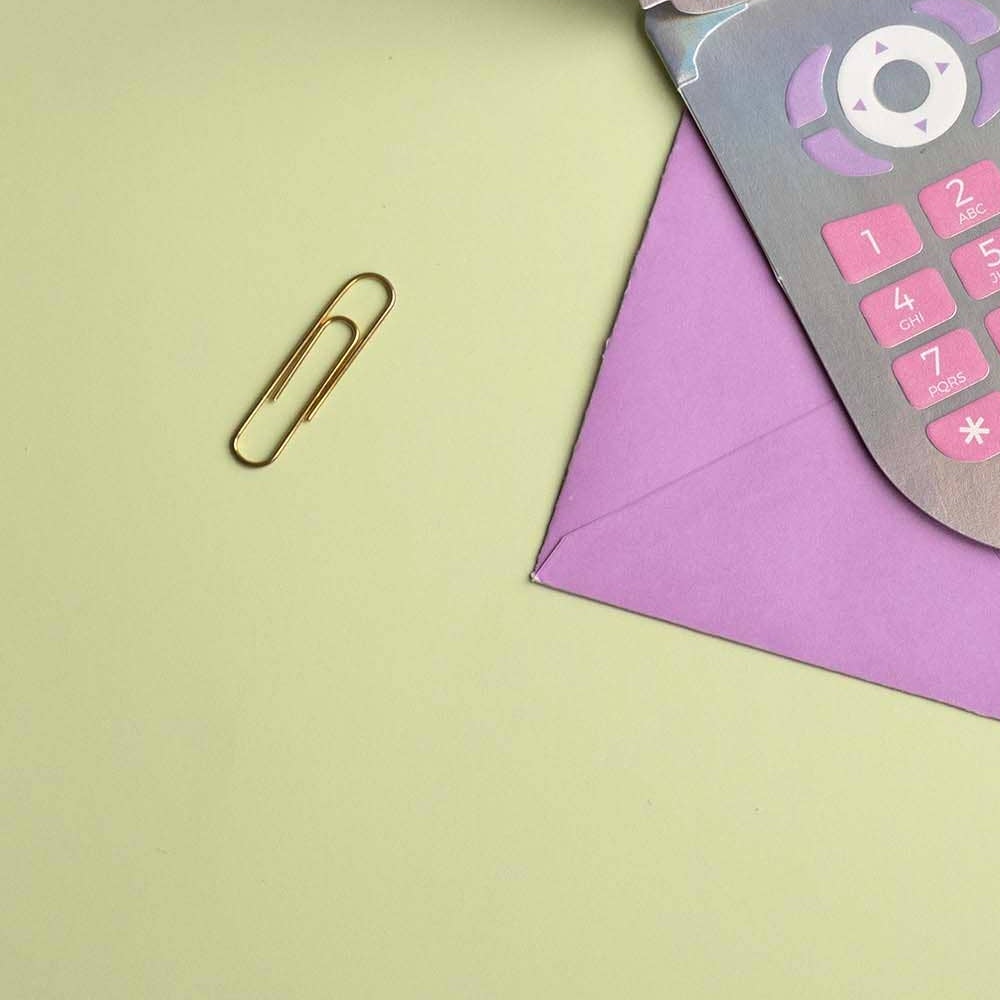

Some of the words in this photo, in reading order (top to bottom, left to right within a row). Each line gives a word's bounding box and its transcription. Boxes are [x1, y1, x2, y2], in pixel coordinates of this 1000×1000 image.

[946, 179, 974, 207] 2
[958, 203, 986, 225] ABC
[860, 229, 881, 254] 1
[893, 287, 915, 311] 4
[899, 313, 925, 332] GHI
[920, 346, 941, 376] 7
[928, 372, 967, 398] PQRS
